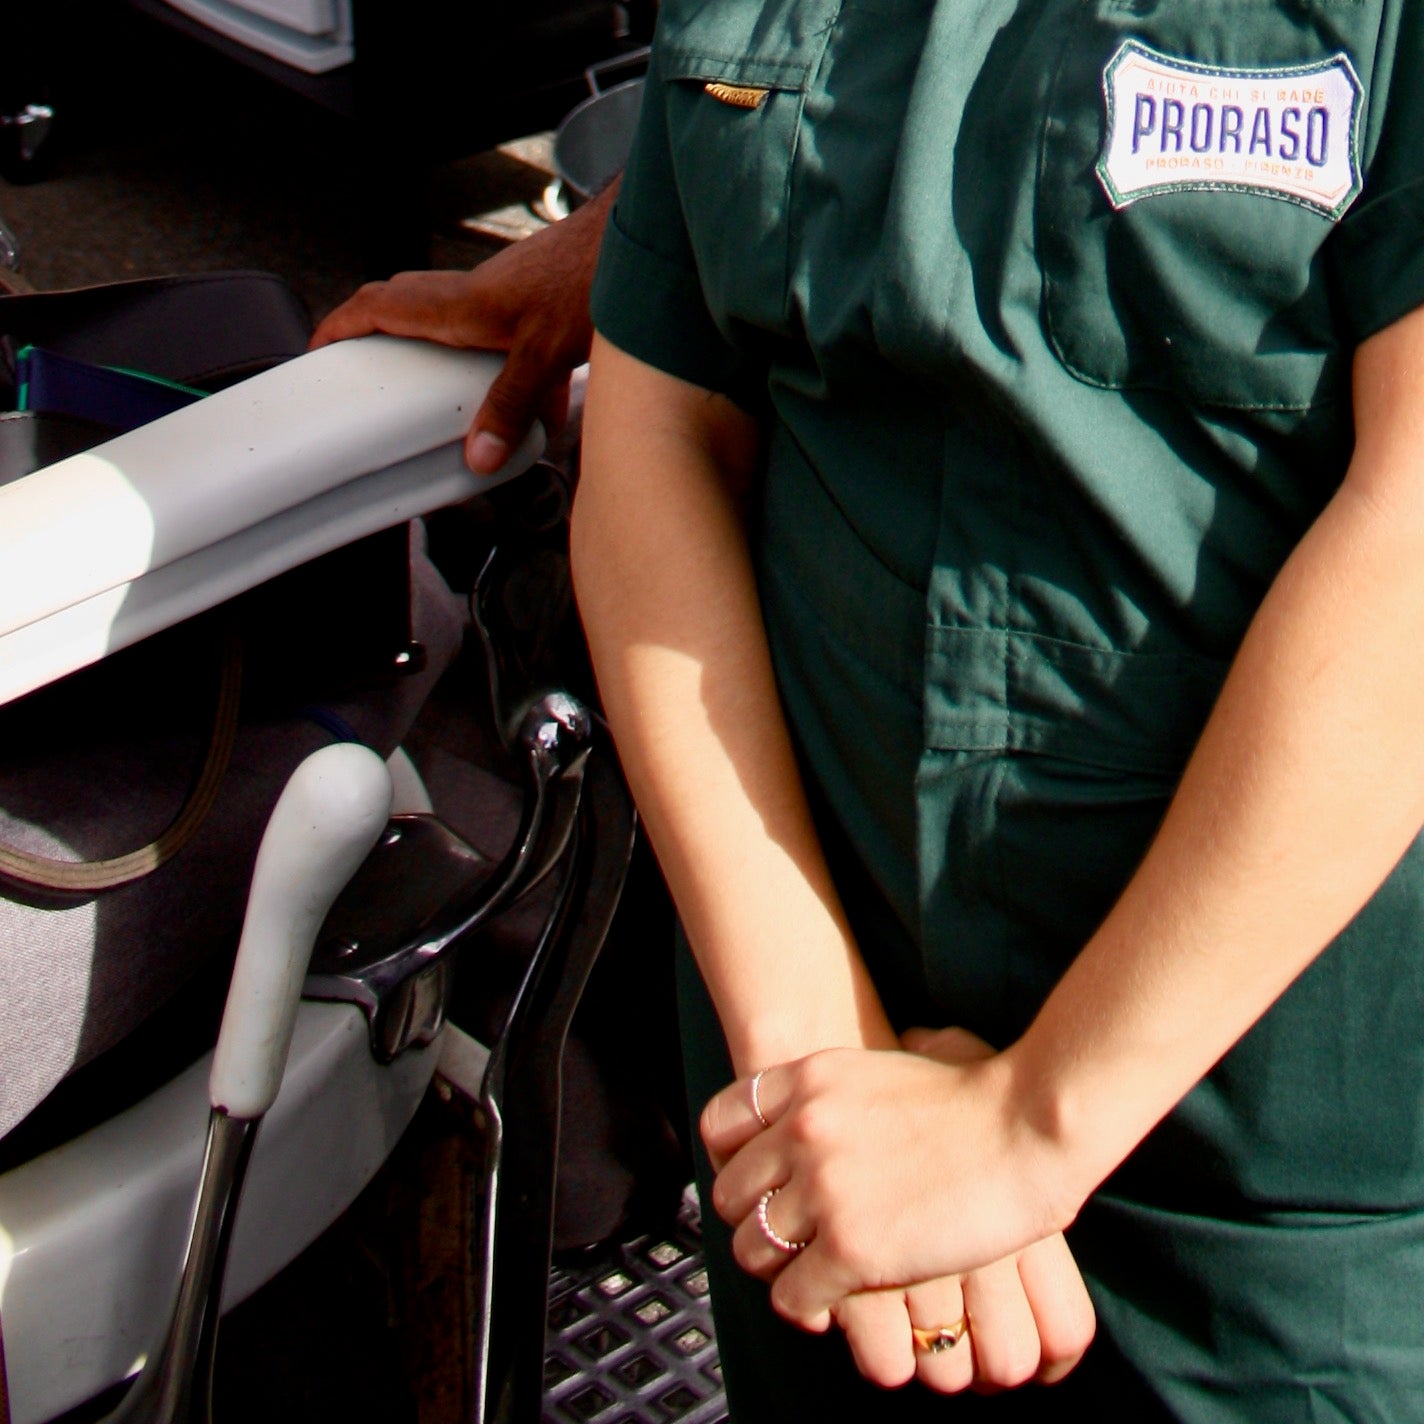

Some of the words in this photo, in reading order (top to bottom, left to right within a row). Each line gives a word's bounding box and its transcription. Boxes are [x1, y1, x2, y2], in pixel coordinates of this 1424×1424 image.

[1147, 79, 1198, 97] AIUTA
[1209, 86, 1239, 101] CHI
[1250, 88, 1267, 102] SI
[1276, 88, 1326, 104] RADE
[1132, 93, 1329, 166] PRORASO
[1146, 157, 1224, 169] PRORASO
[1245, 159, 1314, 181] FIRENZE
